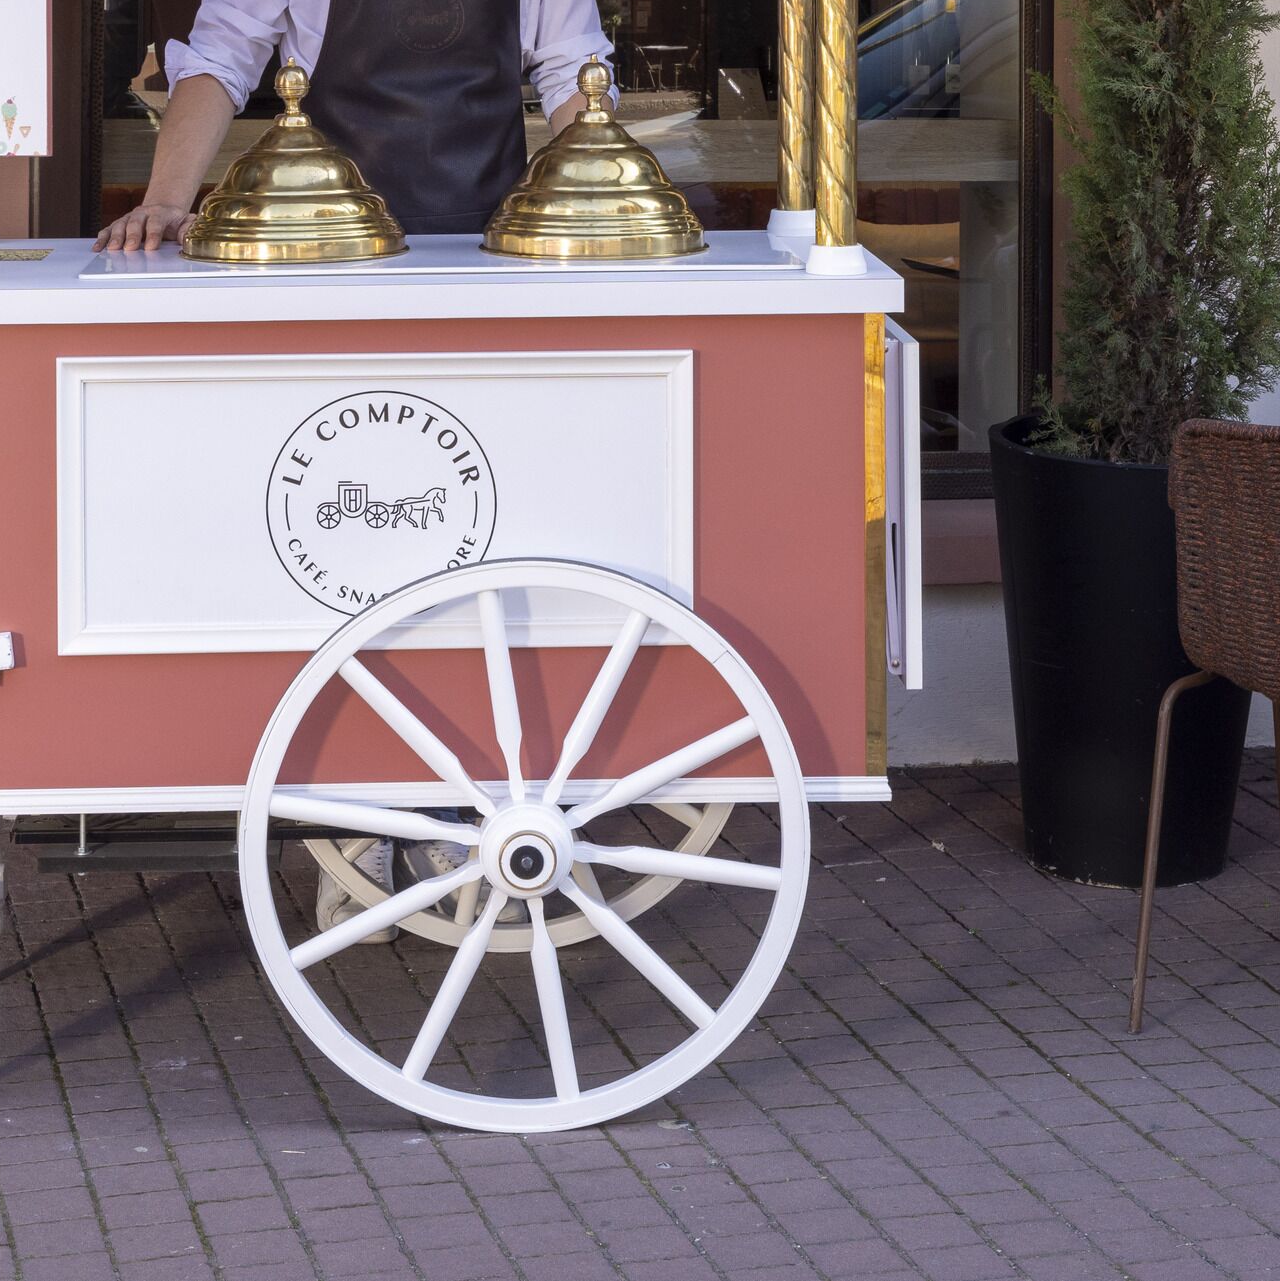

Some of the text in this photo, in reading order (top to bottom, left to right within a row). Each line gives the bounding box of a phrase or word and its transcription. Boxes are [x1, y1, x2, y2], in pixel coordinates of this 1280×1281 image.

[282, 402, 480, 486] LE COMPTOIR
[288, 534, 477, 605] CAFÉ, SNA ORE
